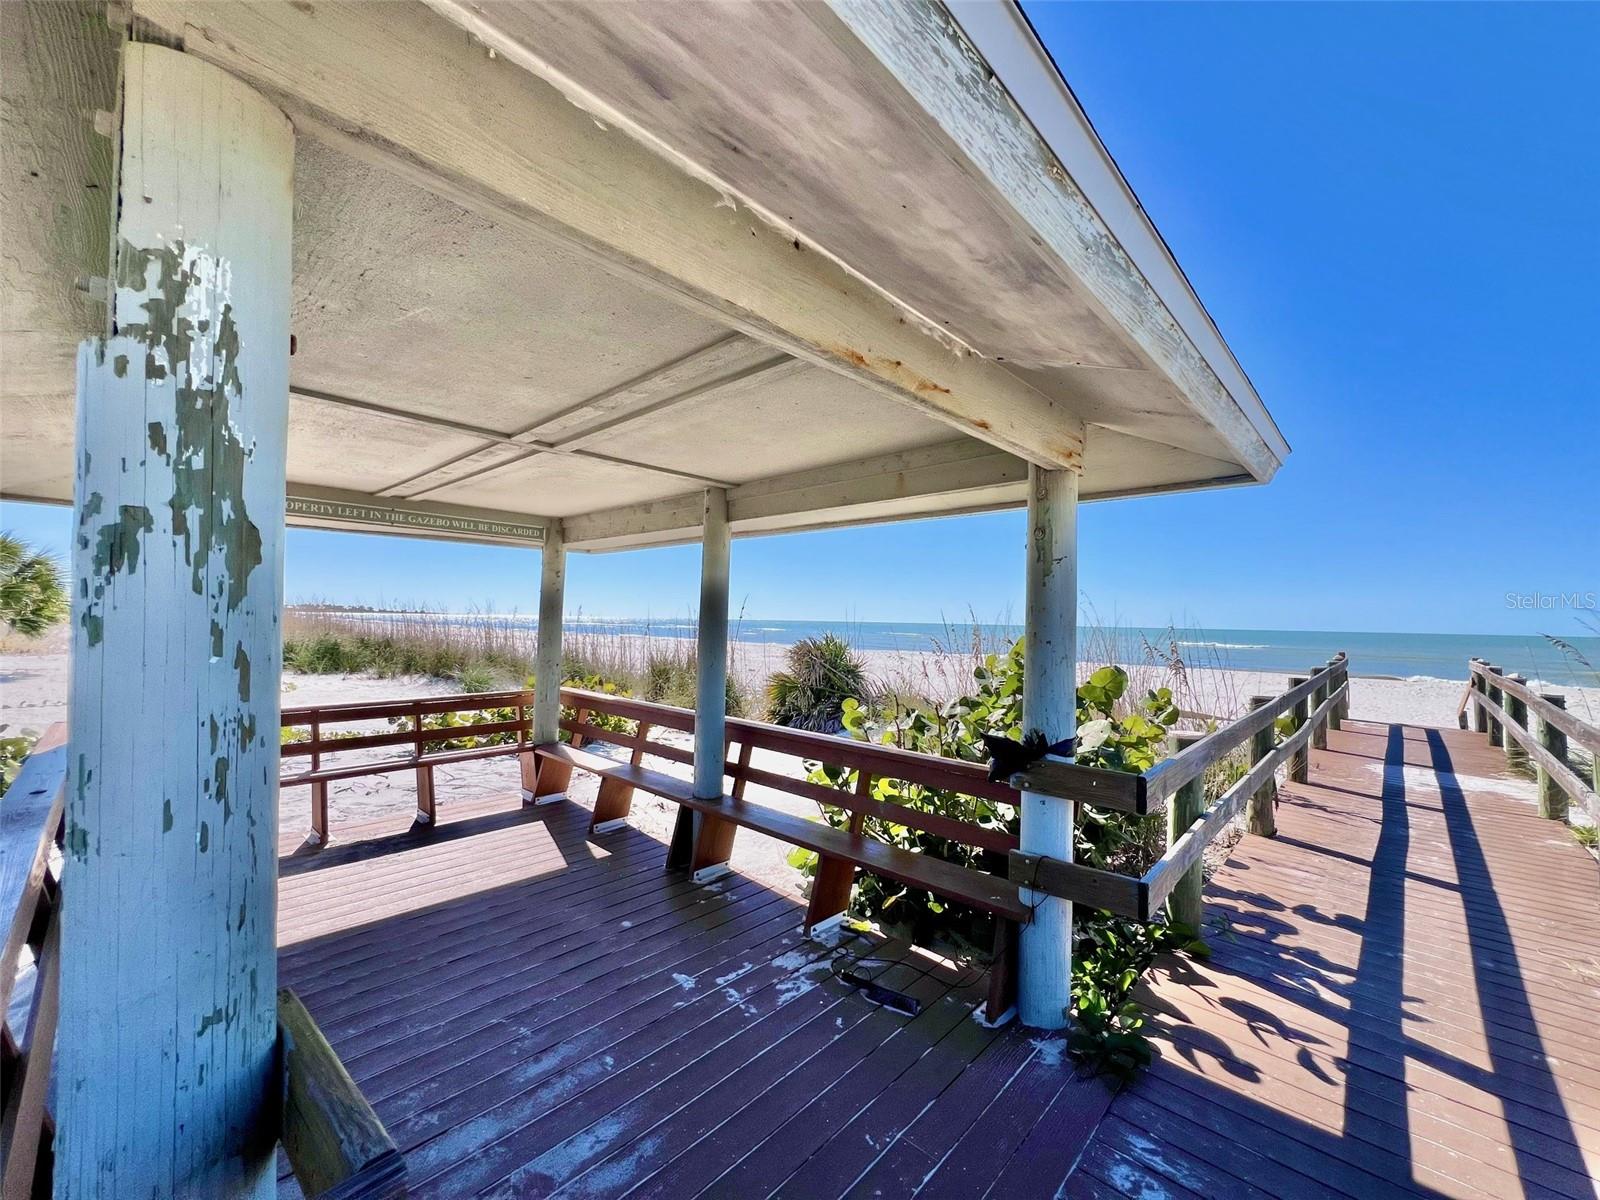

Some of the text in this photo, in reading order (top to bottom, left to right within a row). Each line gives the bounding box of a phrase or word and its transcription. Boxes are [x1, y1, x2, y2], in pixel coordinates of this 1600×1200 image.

[338, 506, 366, 517] LEFT
[370, 510, 382, 520] IN
[384, 512, 407, 522] THE
[408, 515, 450, 527] GAZEBO
[451, 520, 477, 530] WILL
[478, 523, 490, 532] BE
[491, 524, 540, 537] DISCARDED
